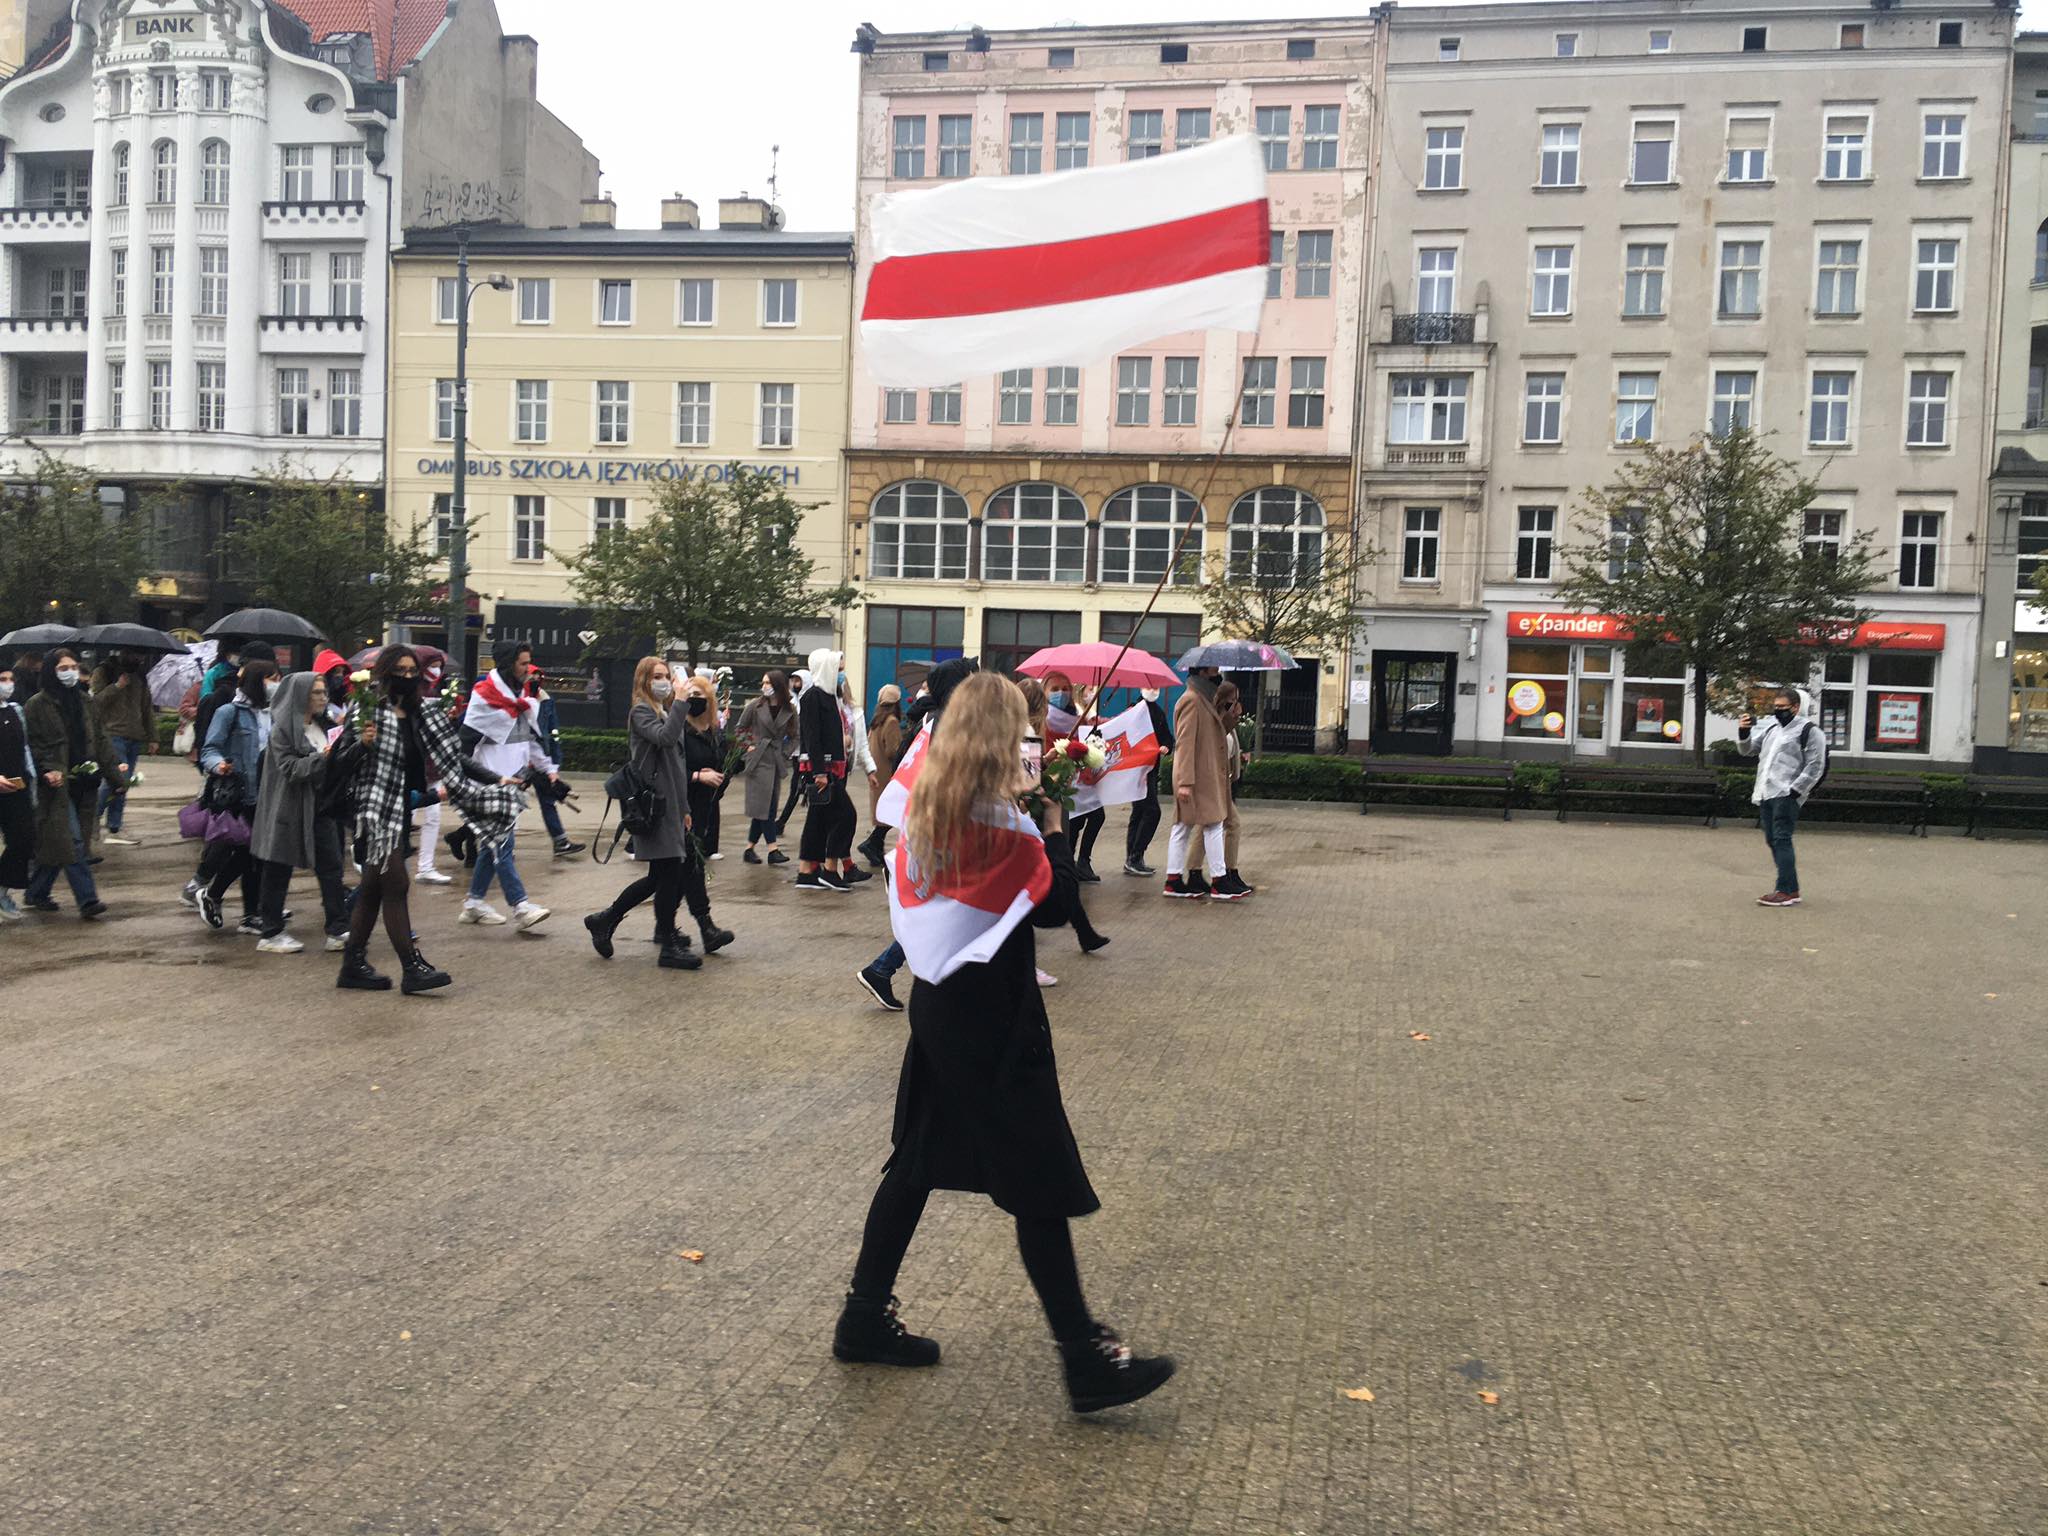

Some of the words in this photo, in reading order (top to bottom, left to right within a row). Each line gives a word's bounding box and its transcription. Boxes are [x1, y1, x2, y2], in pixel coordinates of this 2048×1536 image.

[136, 18, 194, 35] BANK
[509, 459, 592, 480] SZKOŁA
[597, 459, 698, 485] JĘZYKÓW
[1519, 613, 1607, 635] expander
